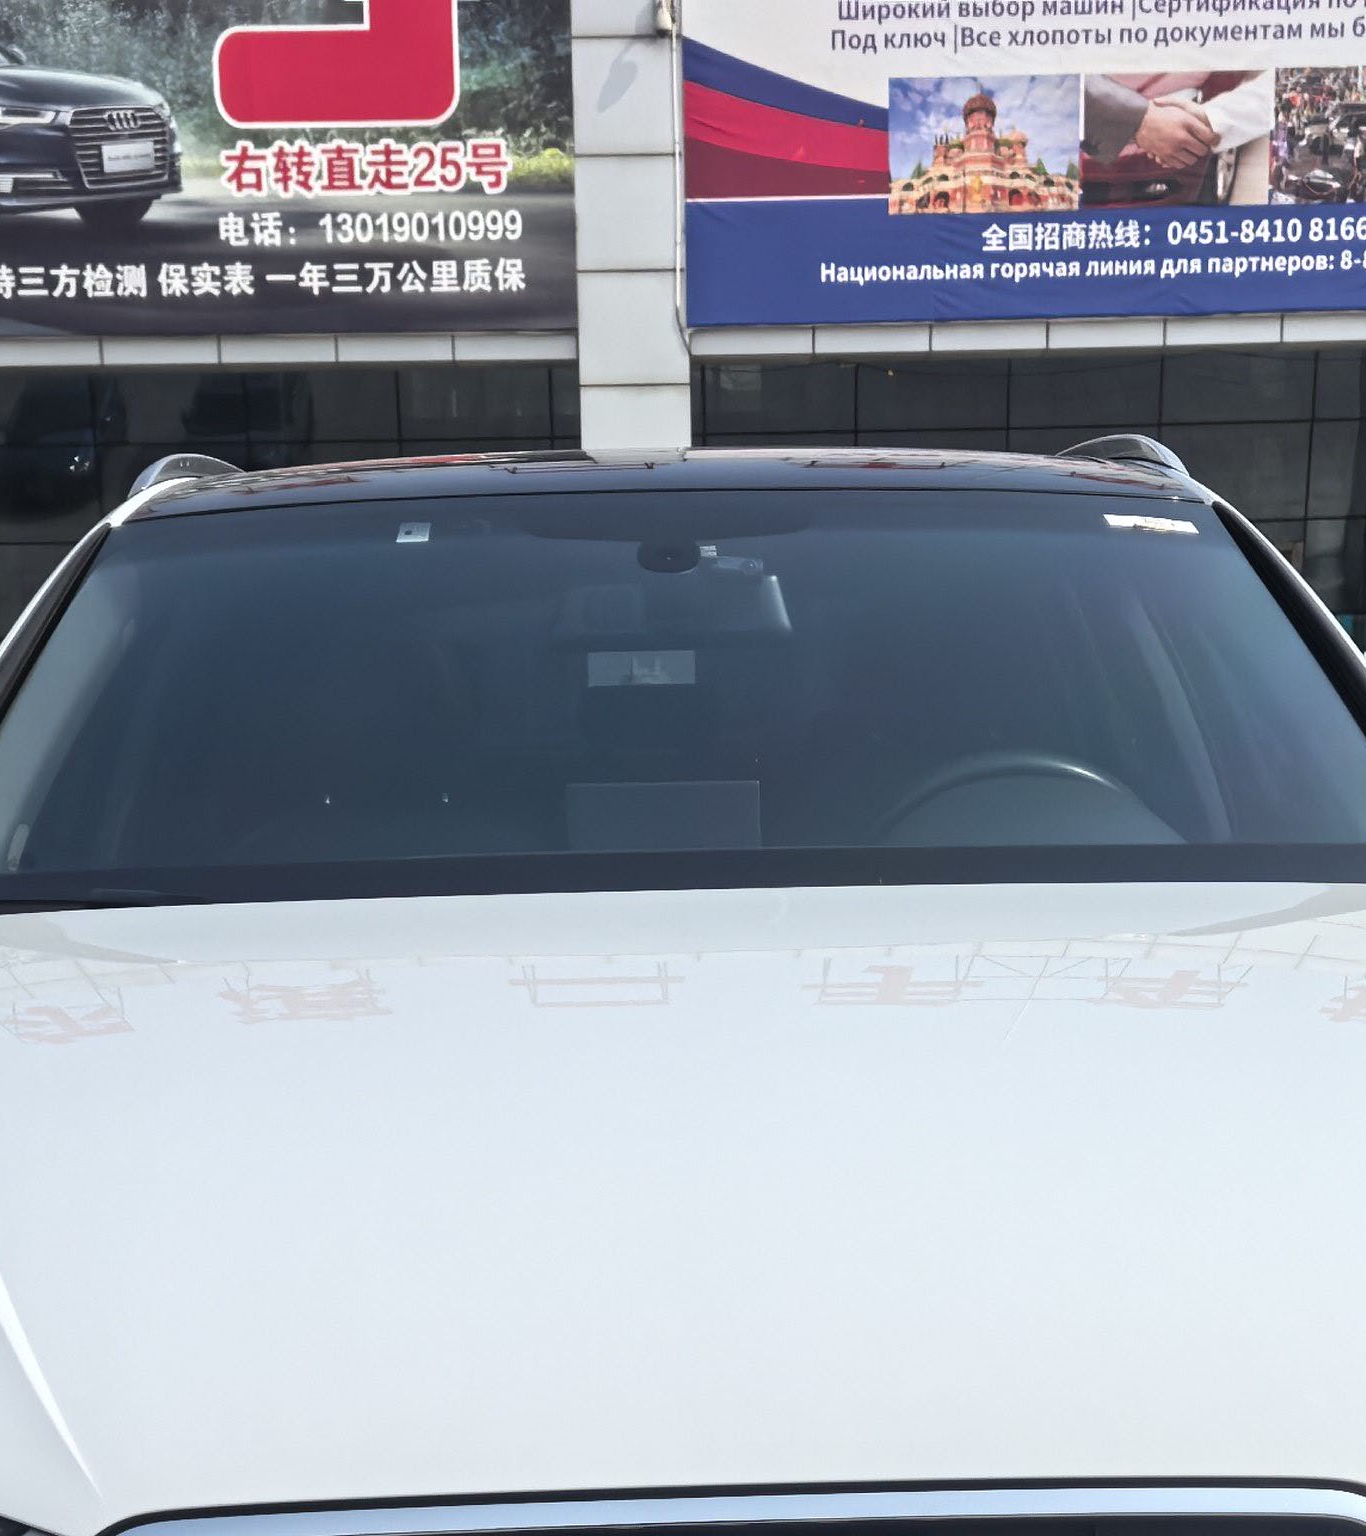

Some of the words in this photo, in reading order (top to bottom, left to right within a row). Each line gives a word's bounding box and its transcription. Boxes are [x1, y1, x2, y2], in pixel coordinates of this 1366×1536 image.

[838, 0, 951, 24] Широкий
[958, 0, 1034, 21] выбор
[1042, 0, 1124, 17] машин
[831, 30, 877, 54] Под
[884, 30, 946, 49] ключ
[1008, 27, 1112, 46] хлопоты
[1119, 26, 1148, 44] по
[1154, 21, 1303, 47] документам
[1310, 21, 1345, 38] мы
[225, 140, 508, 194] 右转直走25号
[320, 209, 523, 244] 13019010999
[1167, 218, 1302, 245] 0451-8410
[158, 262, 255, 297] 保实表
[265, 257, 527, 296] 一年三万公里质保
[820, 261, 985, 286] Национальная
[990, 259, 1081, 283] горячая
[1086, 257, 1156, 276] линия
[1160, 256, 1202, 279] для
[1207, 252, 1335, 276] партнеров:
